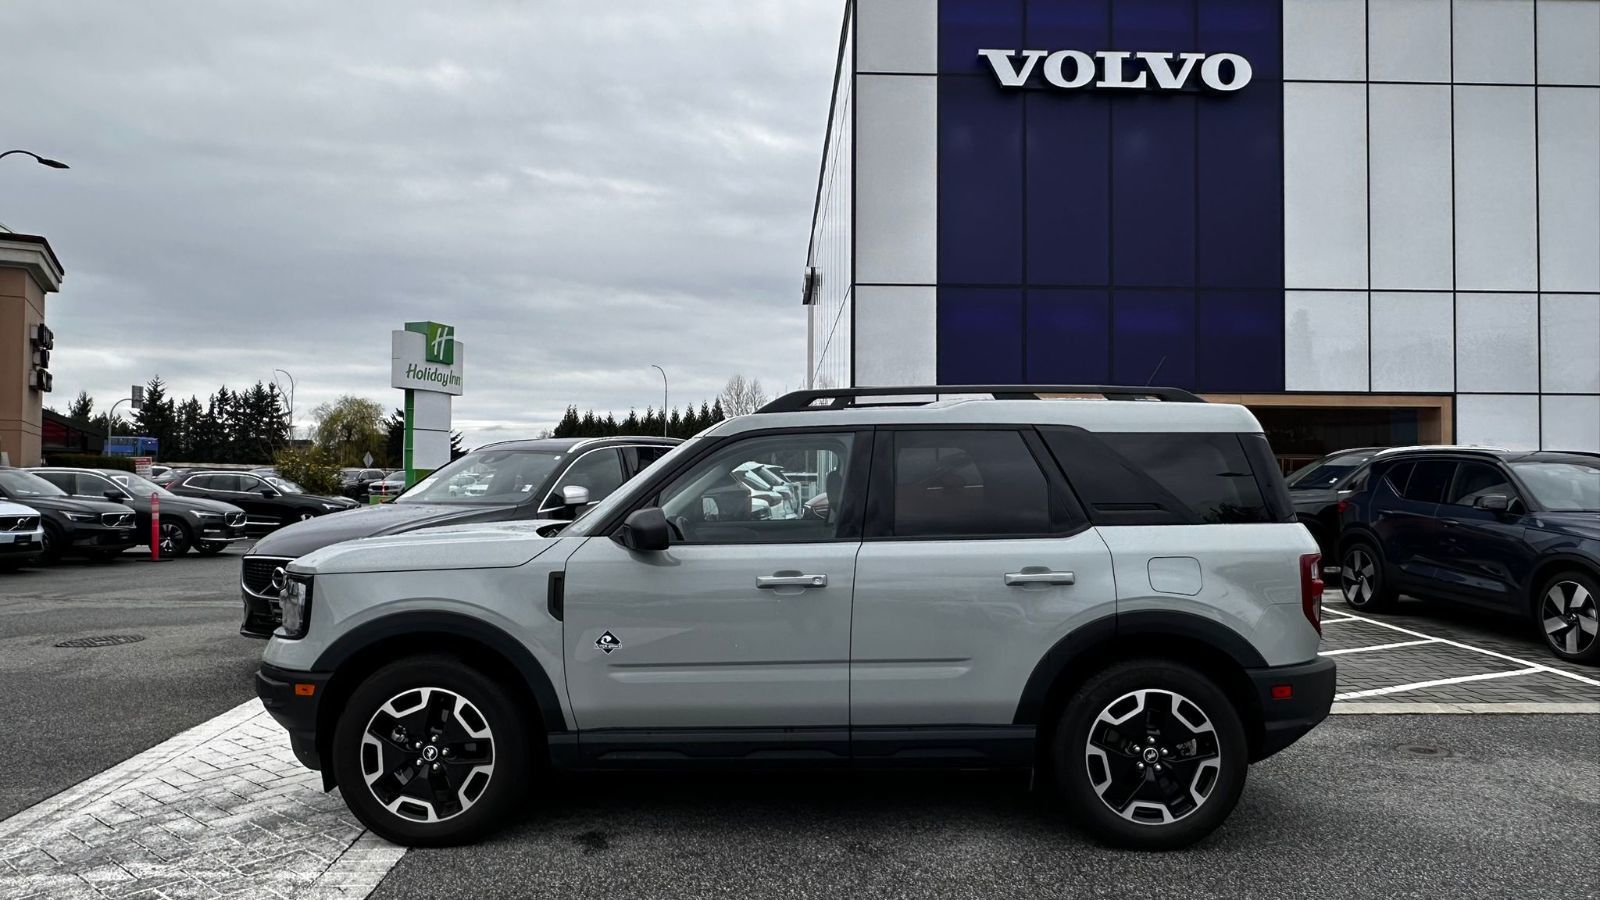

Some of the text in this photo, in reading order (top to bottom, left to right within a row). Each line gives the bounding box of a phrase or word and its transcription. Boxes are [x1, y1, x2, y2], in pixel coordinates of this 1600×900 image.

[978, 49, 1253, 91] VOLVO
[406, 363, 461, 387] Holiday Inn
